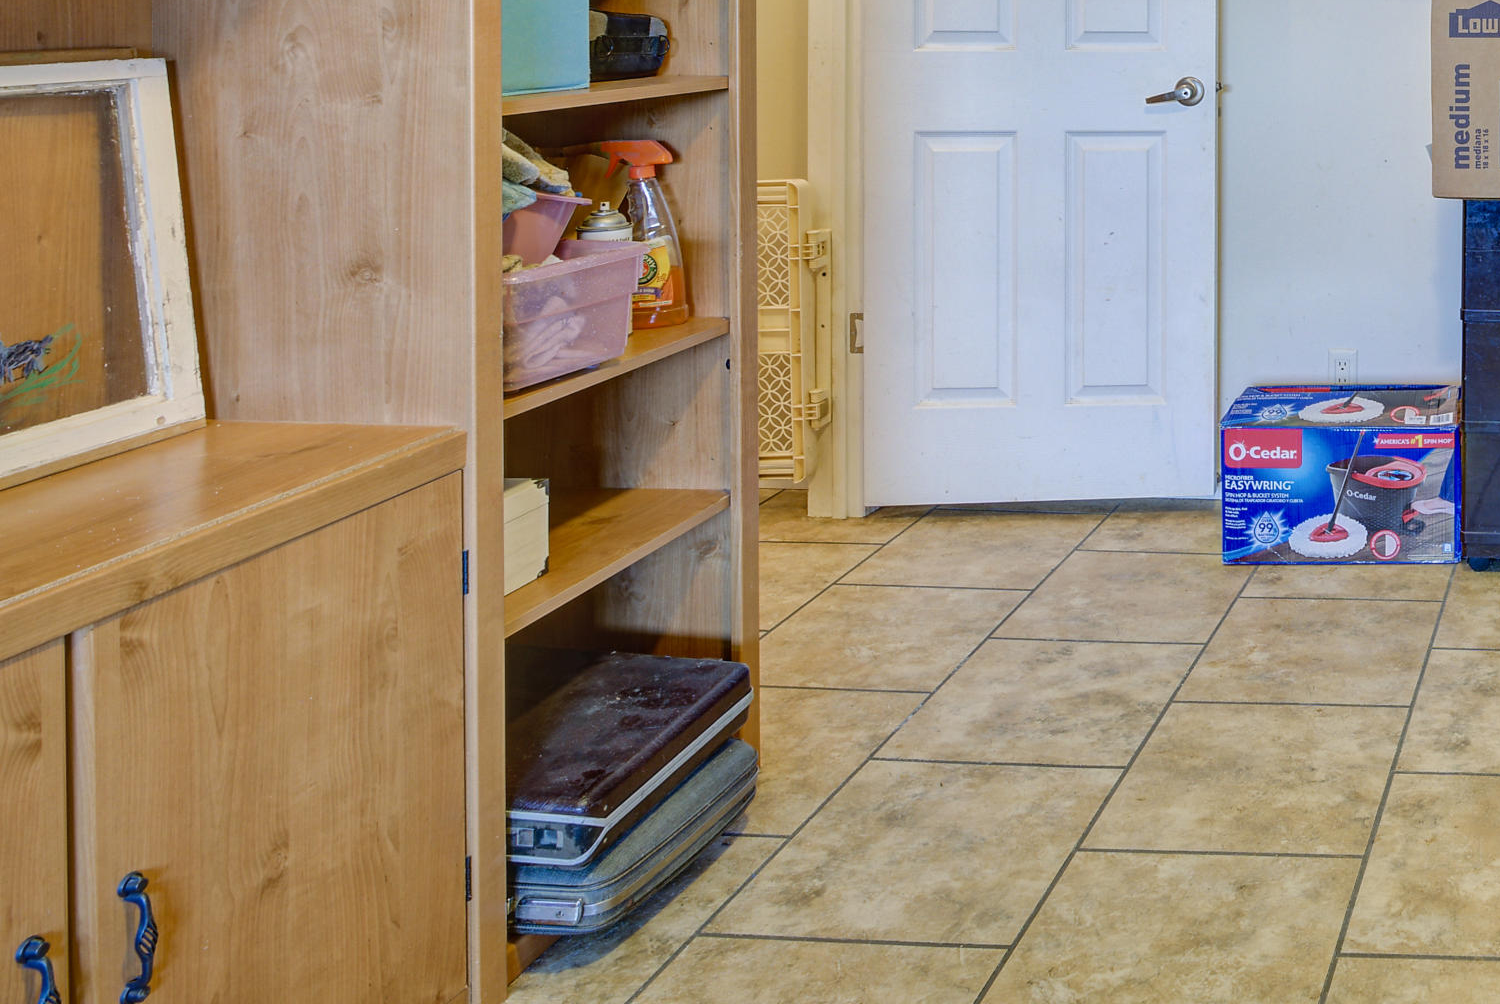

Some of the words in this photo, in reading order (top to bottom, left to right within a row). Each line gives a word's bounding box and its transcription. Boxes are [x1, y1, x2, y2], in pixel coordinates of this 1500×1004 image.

[1448, 63, 1471, 170] medium
[1483, 128, 1489, 137] 16
[1474, 128, 1482, 170] mediana
[1483, 145, 1489, 154] 18
[1483, 161, 1489, 170] 18
[1410, 434, 1423, 448] #1
[1229, 442, 1297, 461] O-Cedar
[1224, 480, 1292, 491] EASYWRING
[1346, 489, 1377, 501] O-Cedar
[1258, 522, 1274, 533] 99
